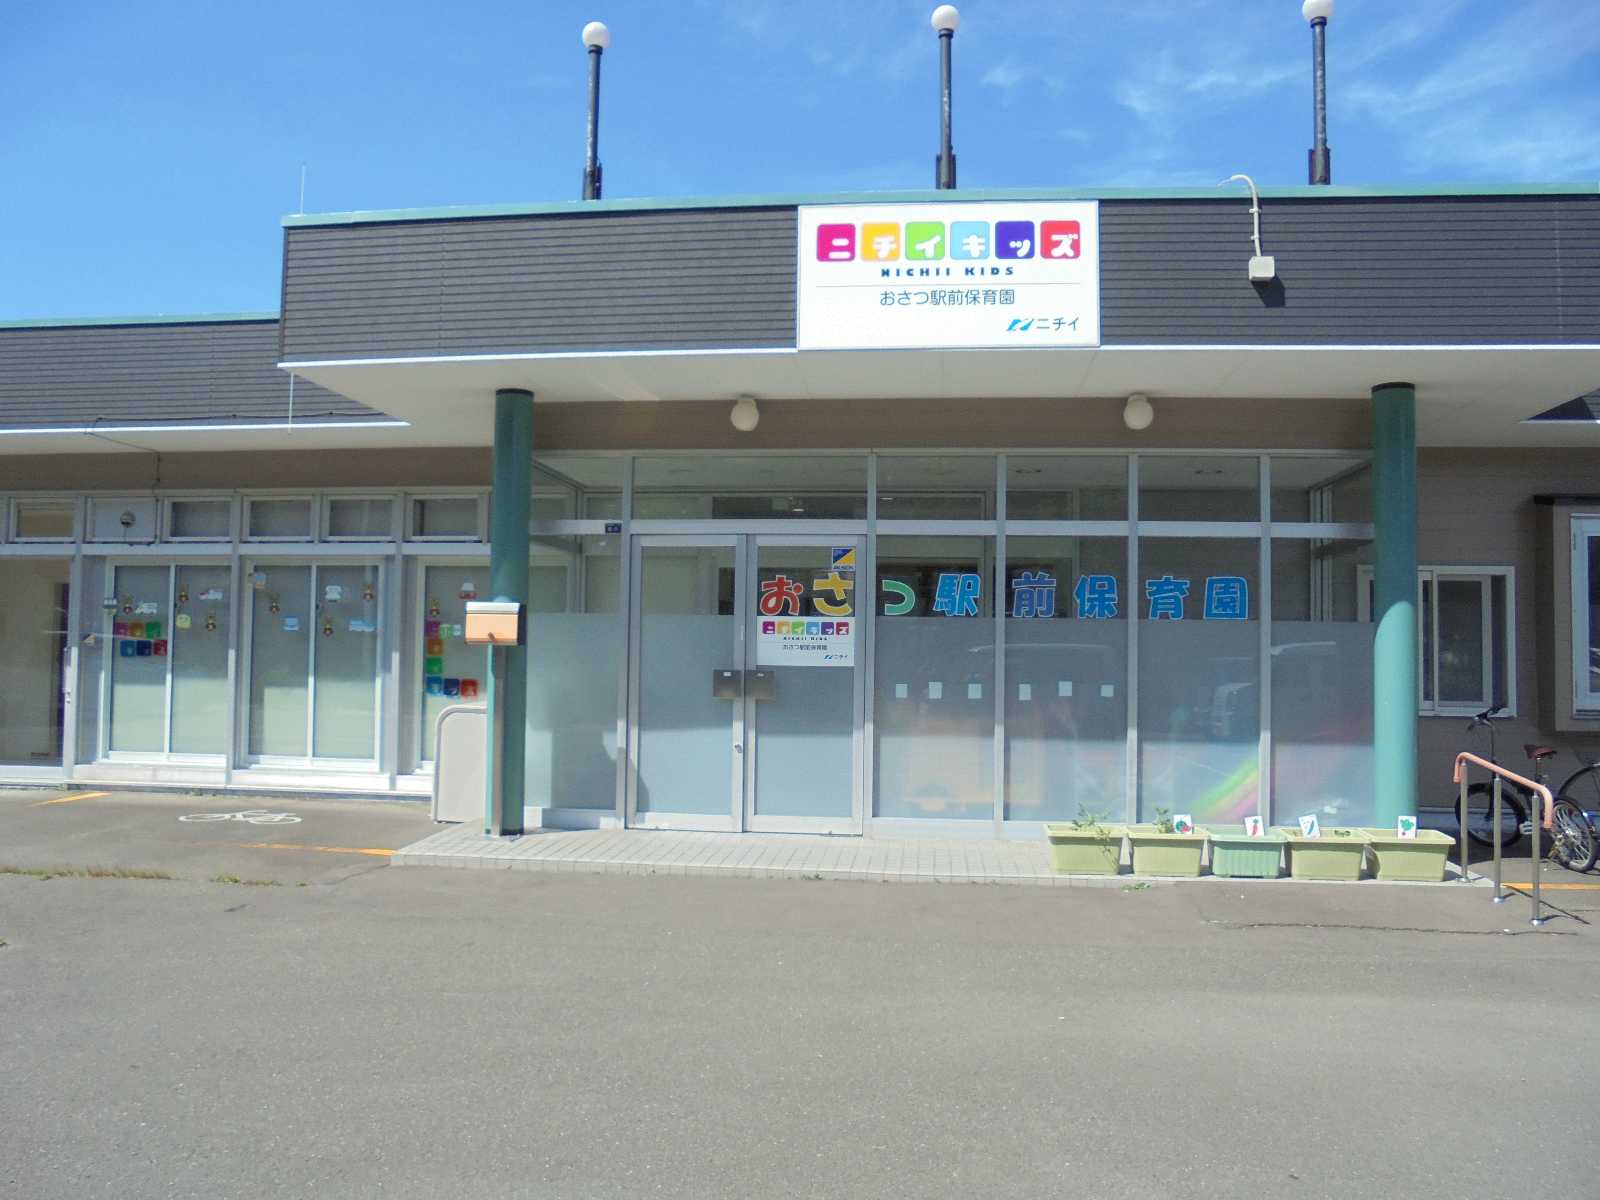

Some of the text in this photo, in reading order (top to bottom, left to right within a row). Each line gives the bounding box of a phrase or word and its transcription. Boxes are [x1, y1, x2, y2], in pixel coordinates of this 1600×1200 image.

[821, 228, 1080, 261] ニチイキッズ
[880, 266, 1014, 277] NICHII KIDS
[880, 289, 1015, 306] おさつ駅前保育園
[1036, 317, 1079, 331] ニチイ
[760, 571, 1248, 620] おさつ駅前保育園
